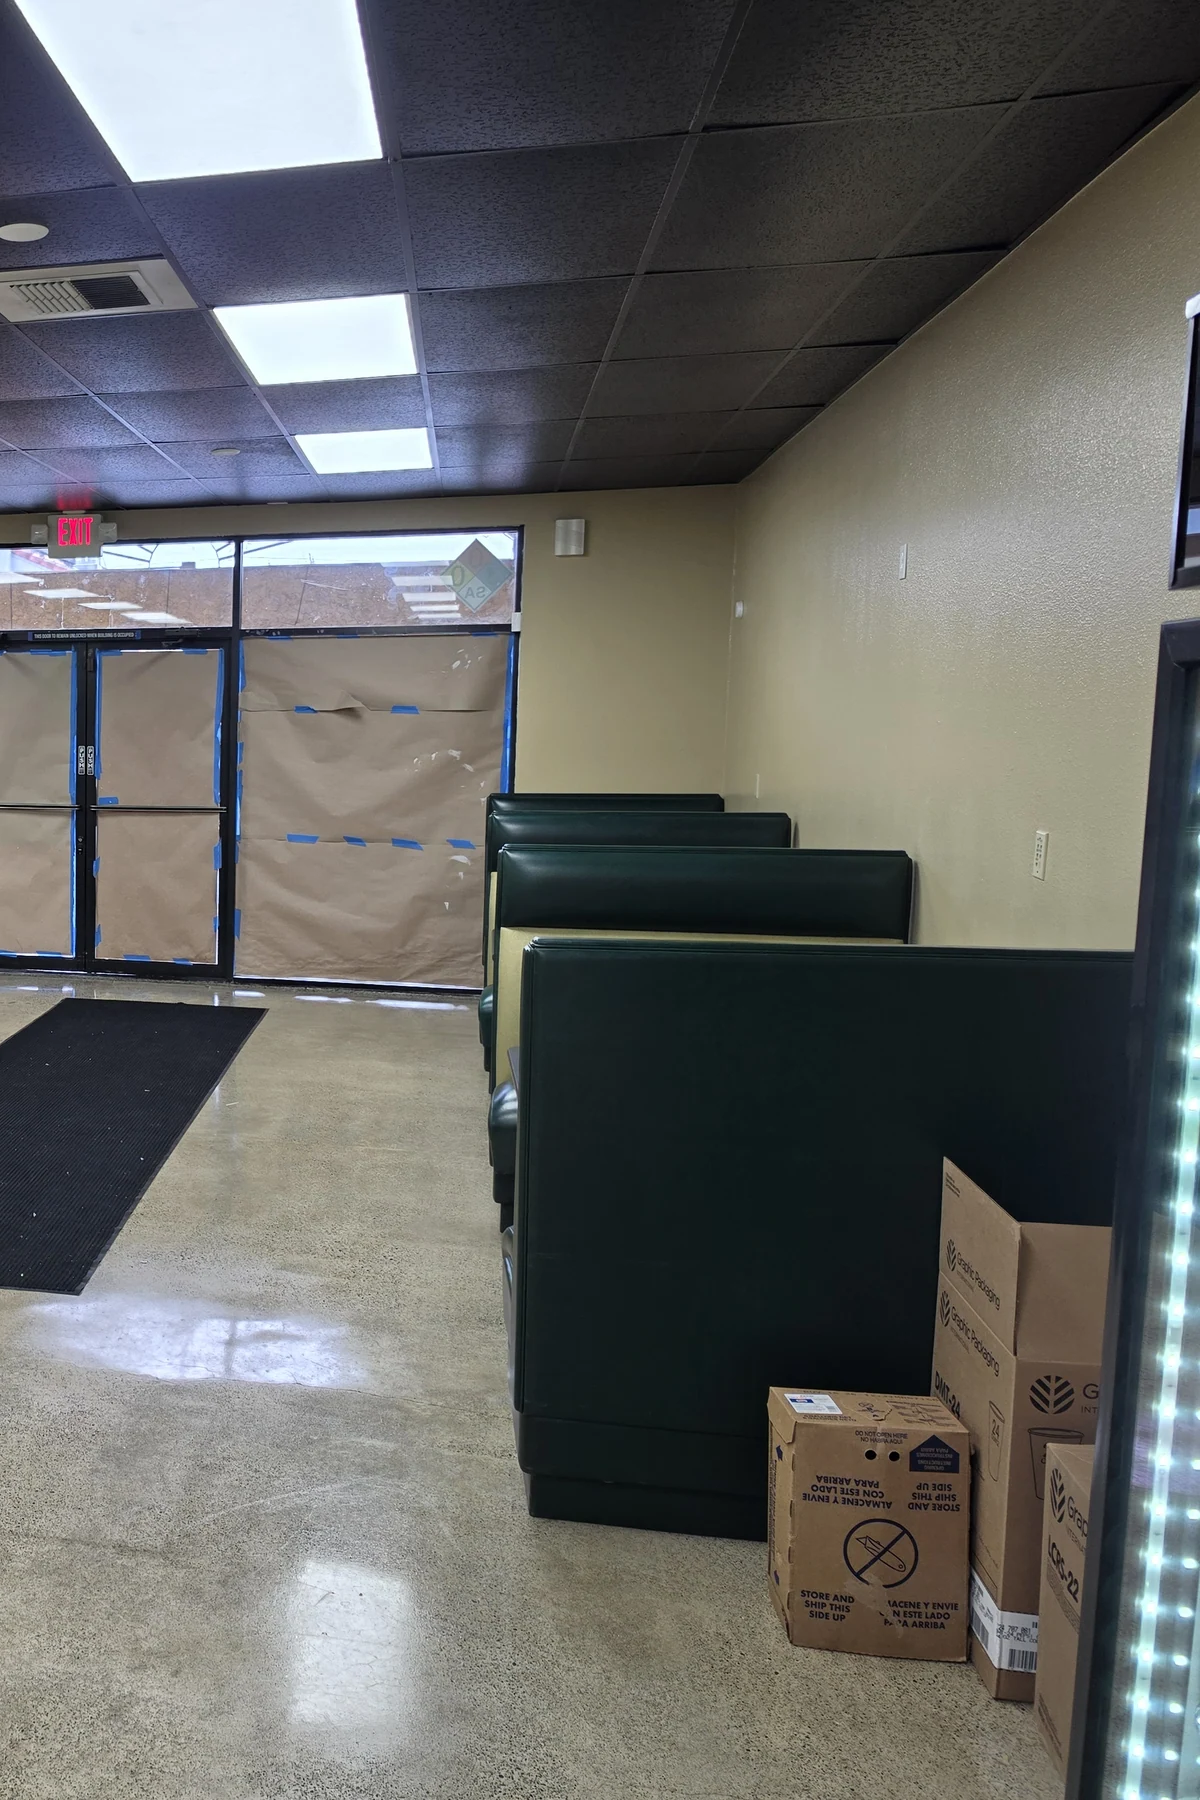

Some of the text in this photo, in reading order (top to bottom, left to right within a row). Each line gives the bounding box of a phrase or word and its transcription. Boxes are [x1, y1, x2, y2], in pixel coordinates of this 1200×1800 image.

[58, 517, 93, 546] EXIT
[957, 1252, 975, 1281] Graphic
[975, 1271, 1000, 1311] Packaging
[951, 1306, 971, 1341] Graphic
[971, 1330, 1000, 1378] Packaging
[935, 1370, 961, 1421] DMT-24
[815, 1474, 880, 1489] PARA ARRIBA
[915, 1482, 953, 1492] SIDE UP
[810, 1484, 885, 1499] CON ESTE LADO
[911, 1492, 957, 1502] SHIP THIS
[802, 1492, 893, 1510] ALMACENE Y ENVIE
[907, 1502, 961, 1512] STORE AND
[800, 1590, 855, 1604] STORE AND
[804, 1599, 851, 1613] SHIP THIS
[888, 1599, 959, 1611] ACENE Y ENVIE
[809, 1610, 846, 1622] SIDE UP
[903, 1610, 923, 1619] ESTE
[925, 1611, 951, 1621] LADO
[884, 1618, 946, 1630] PA ARRIBA
